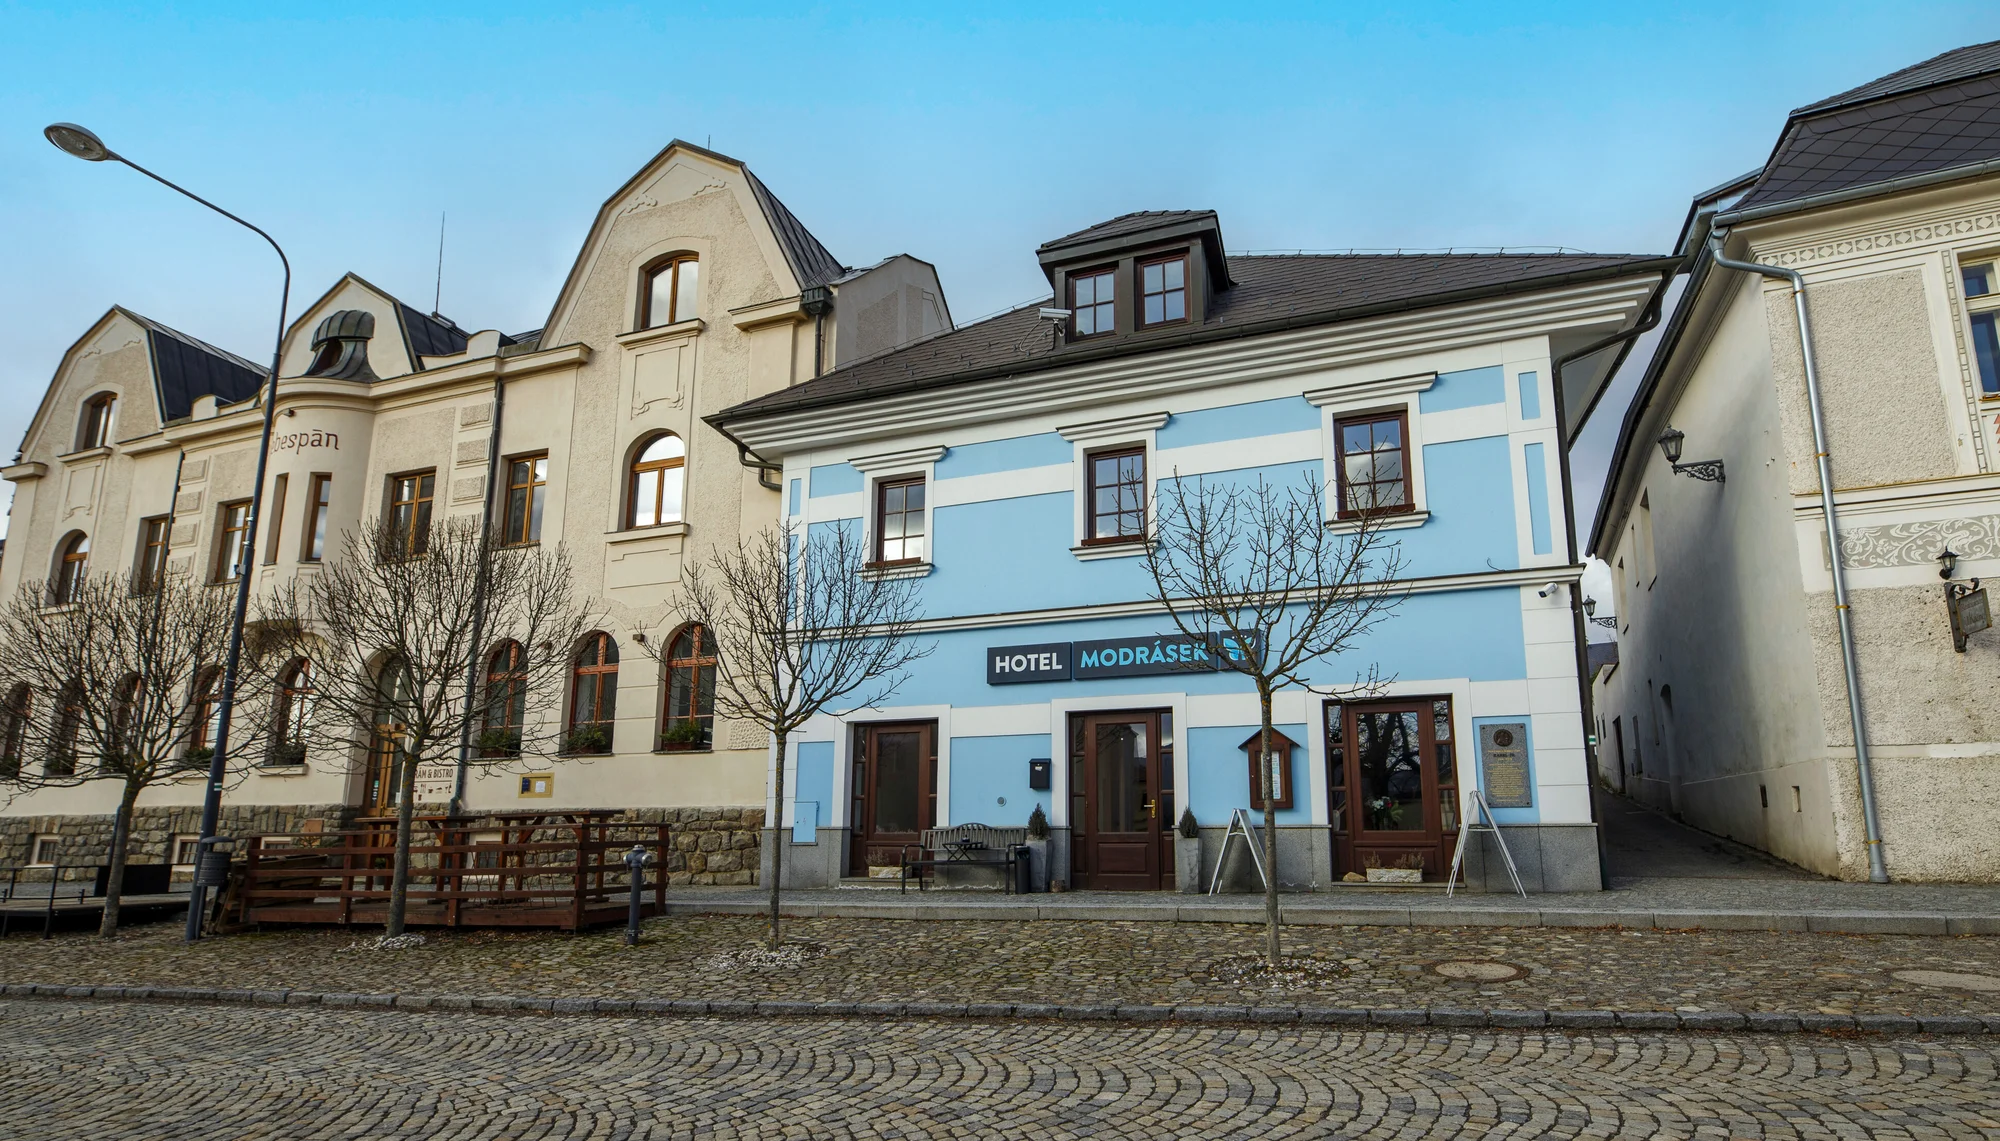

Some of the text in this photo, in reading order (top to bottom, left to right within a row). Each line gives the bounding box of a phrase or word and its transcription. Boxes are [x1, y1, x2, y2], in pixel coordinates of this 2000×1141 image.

[995, 640, 1210, 673] HOTEL MODRÁSEK
[414, 767, 453, 778] RÁM & BISTRO
